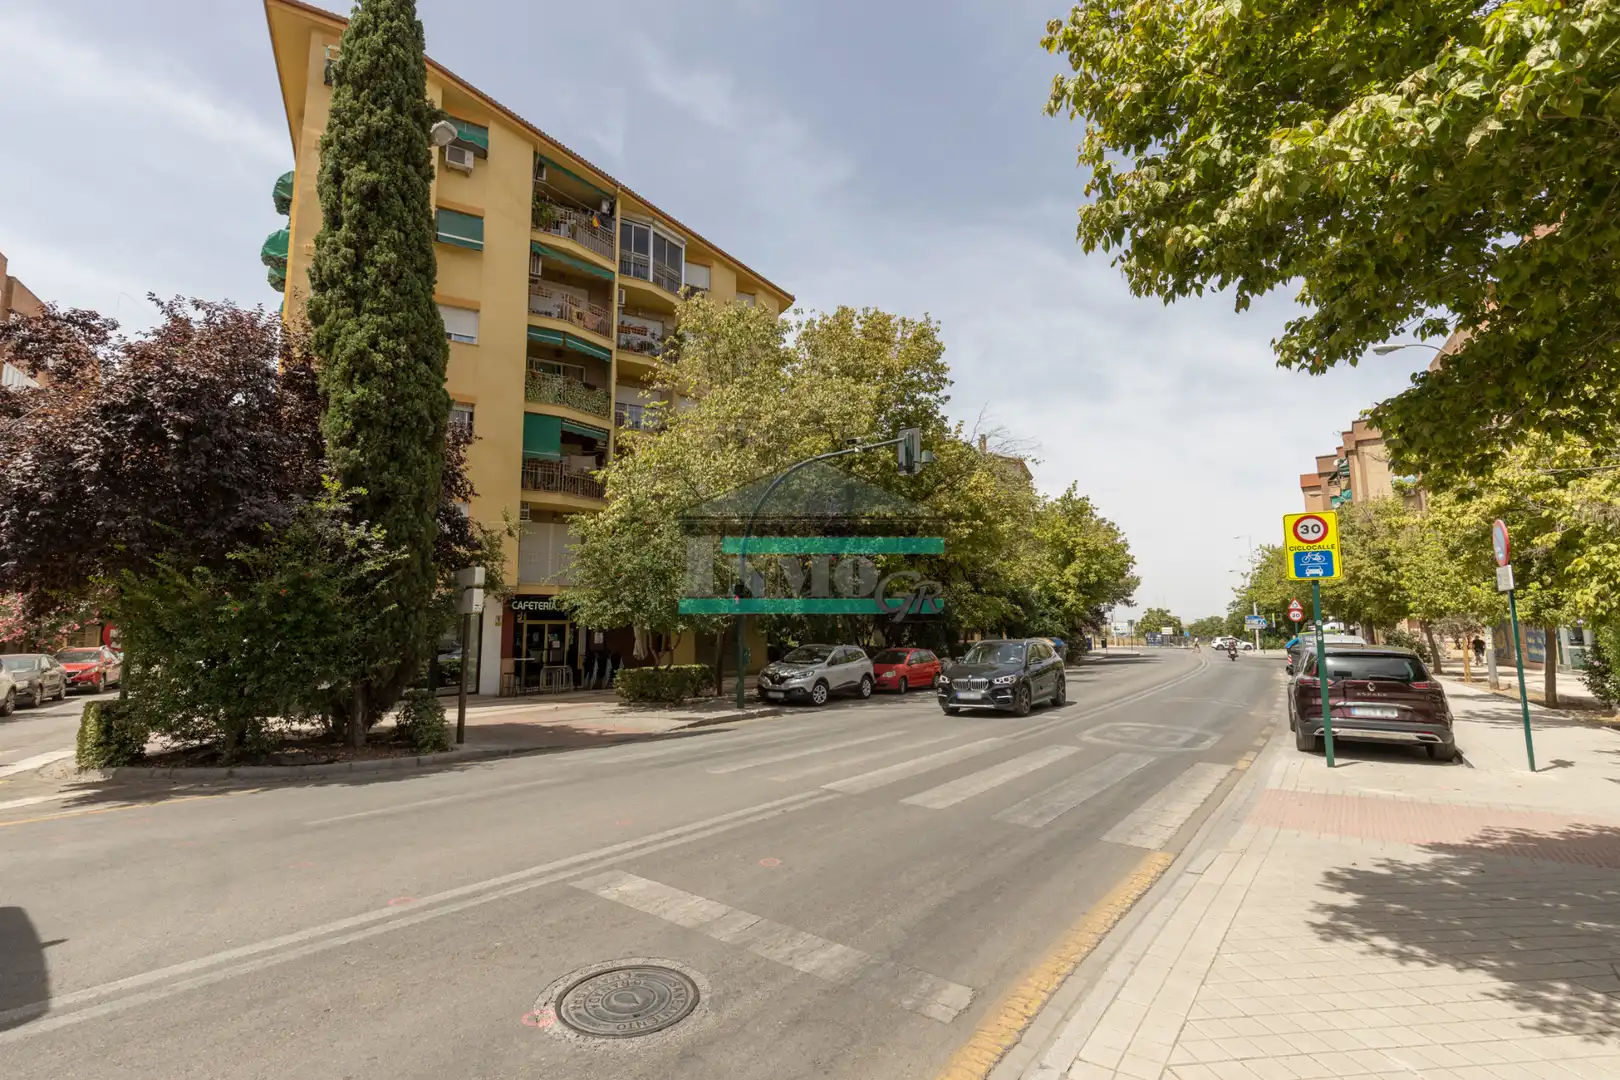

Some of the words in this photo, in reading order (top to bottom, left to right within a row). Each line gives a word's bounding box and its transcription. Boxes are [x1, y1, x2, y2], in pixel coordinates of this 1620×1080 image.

[1300, 524, 1321, 534] 30
[1289, 544, 1335, 552] CICLOCALLE
[616, 981, 685, 1031] SANEAMIENTO
